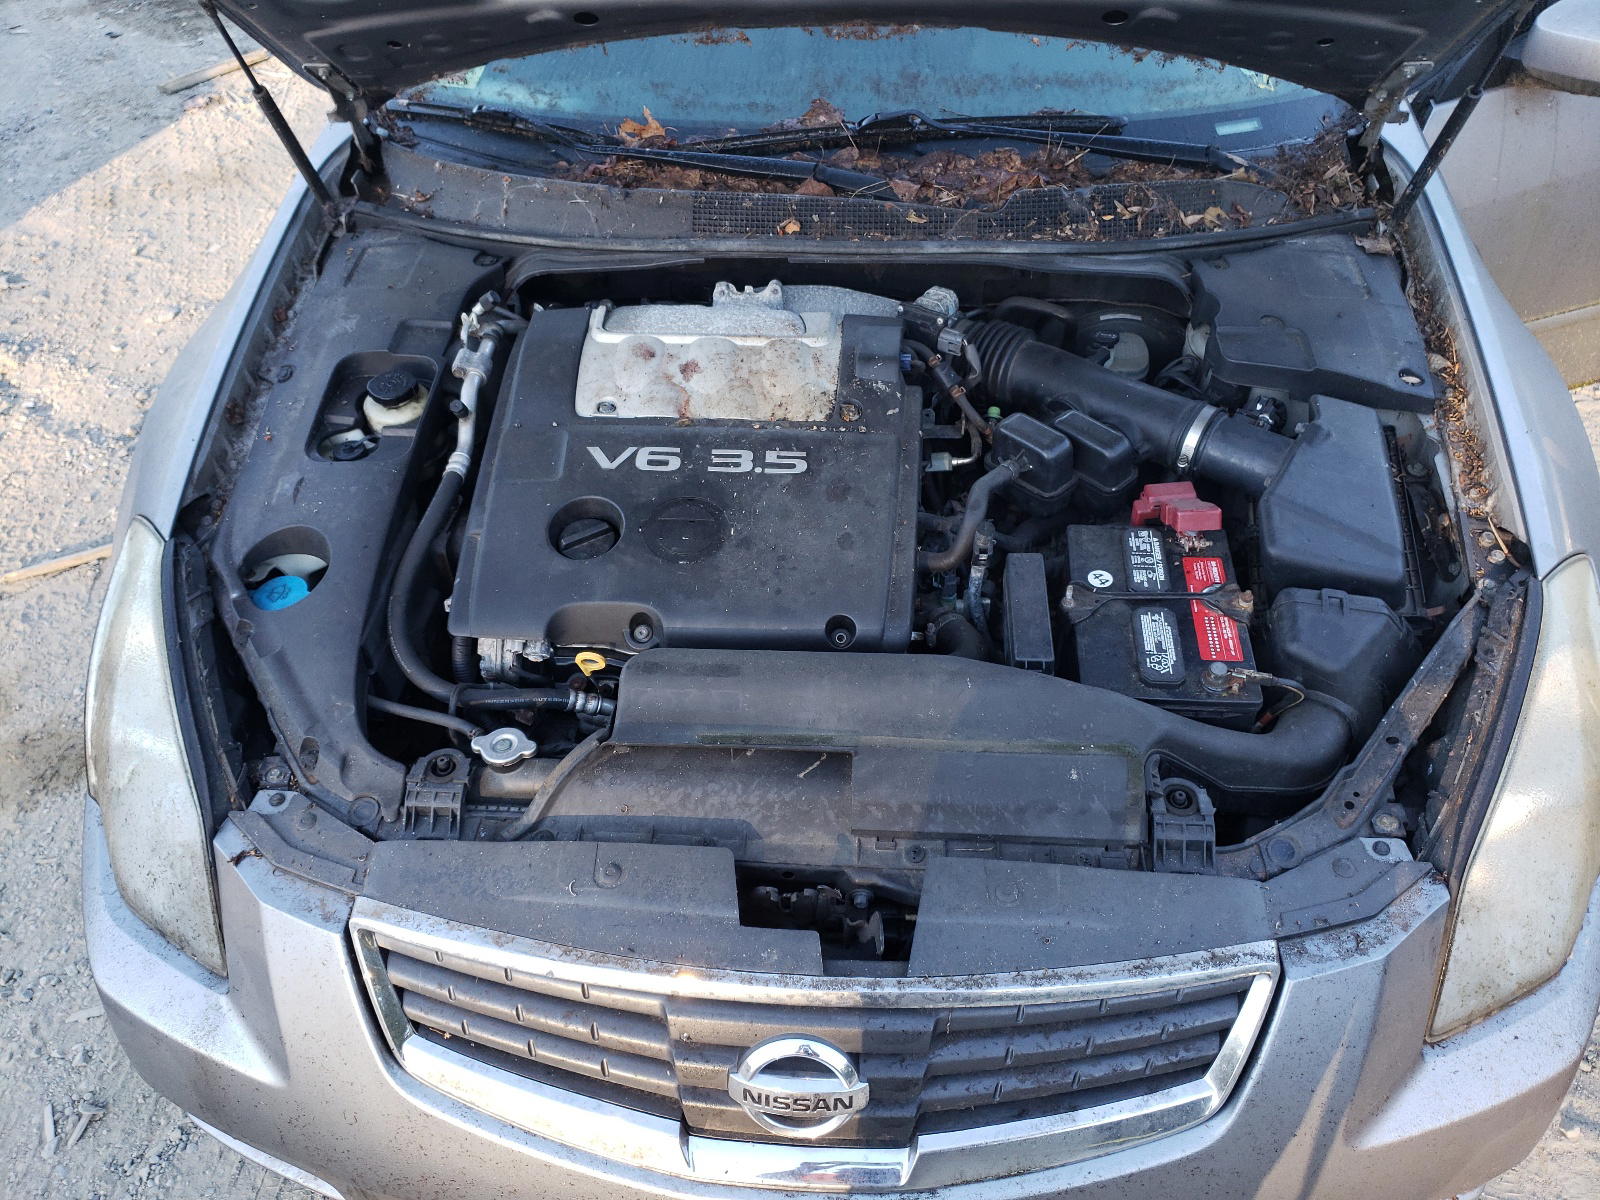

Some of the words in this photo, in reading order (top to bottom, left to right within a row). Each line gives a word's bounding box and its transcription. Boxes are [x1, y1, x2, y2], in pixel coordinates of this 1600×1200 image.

[586, 446, 681, 472] V6
[707, 448, 808, 474] 3.5
[742, 1087, 853, 1112] NISSAN
